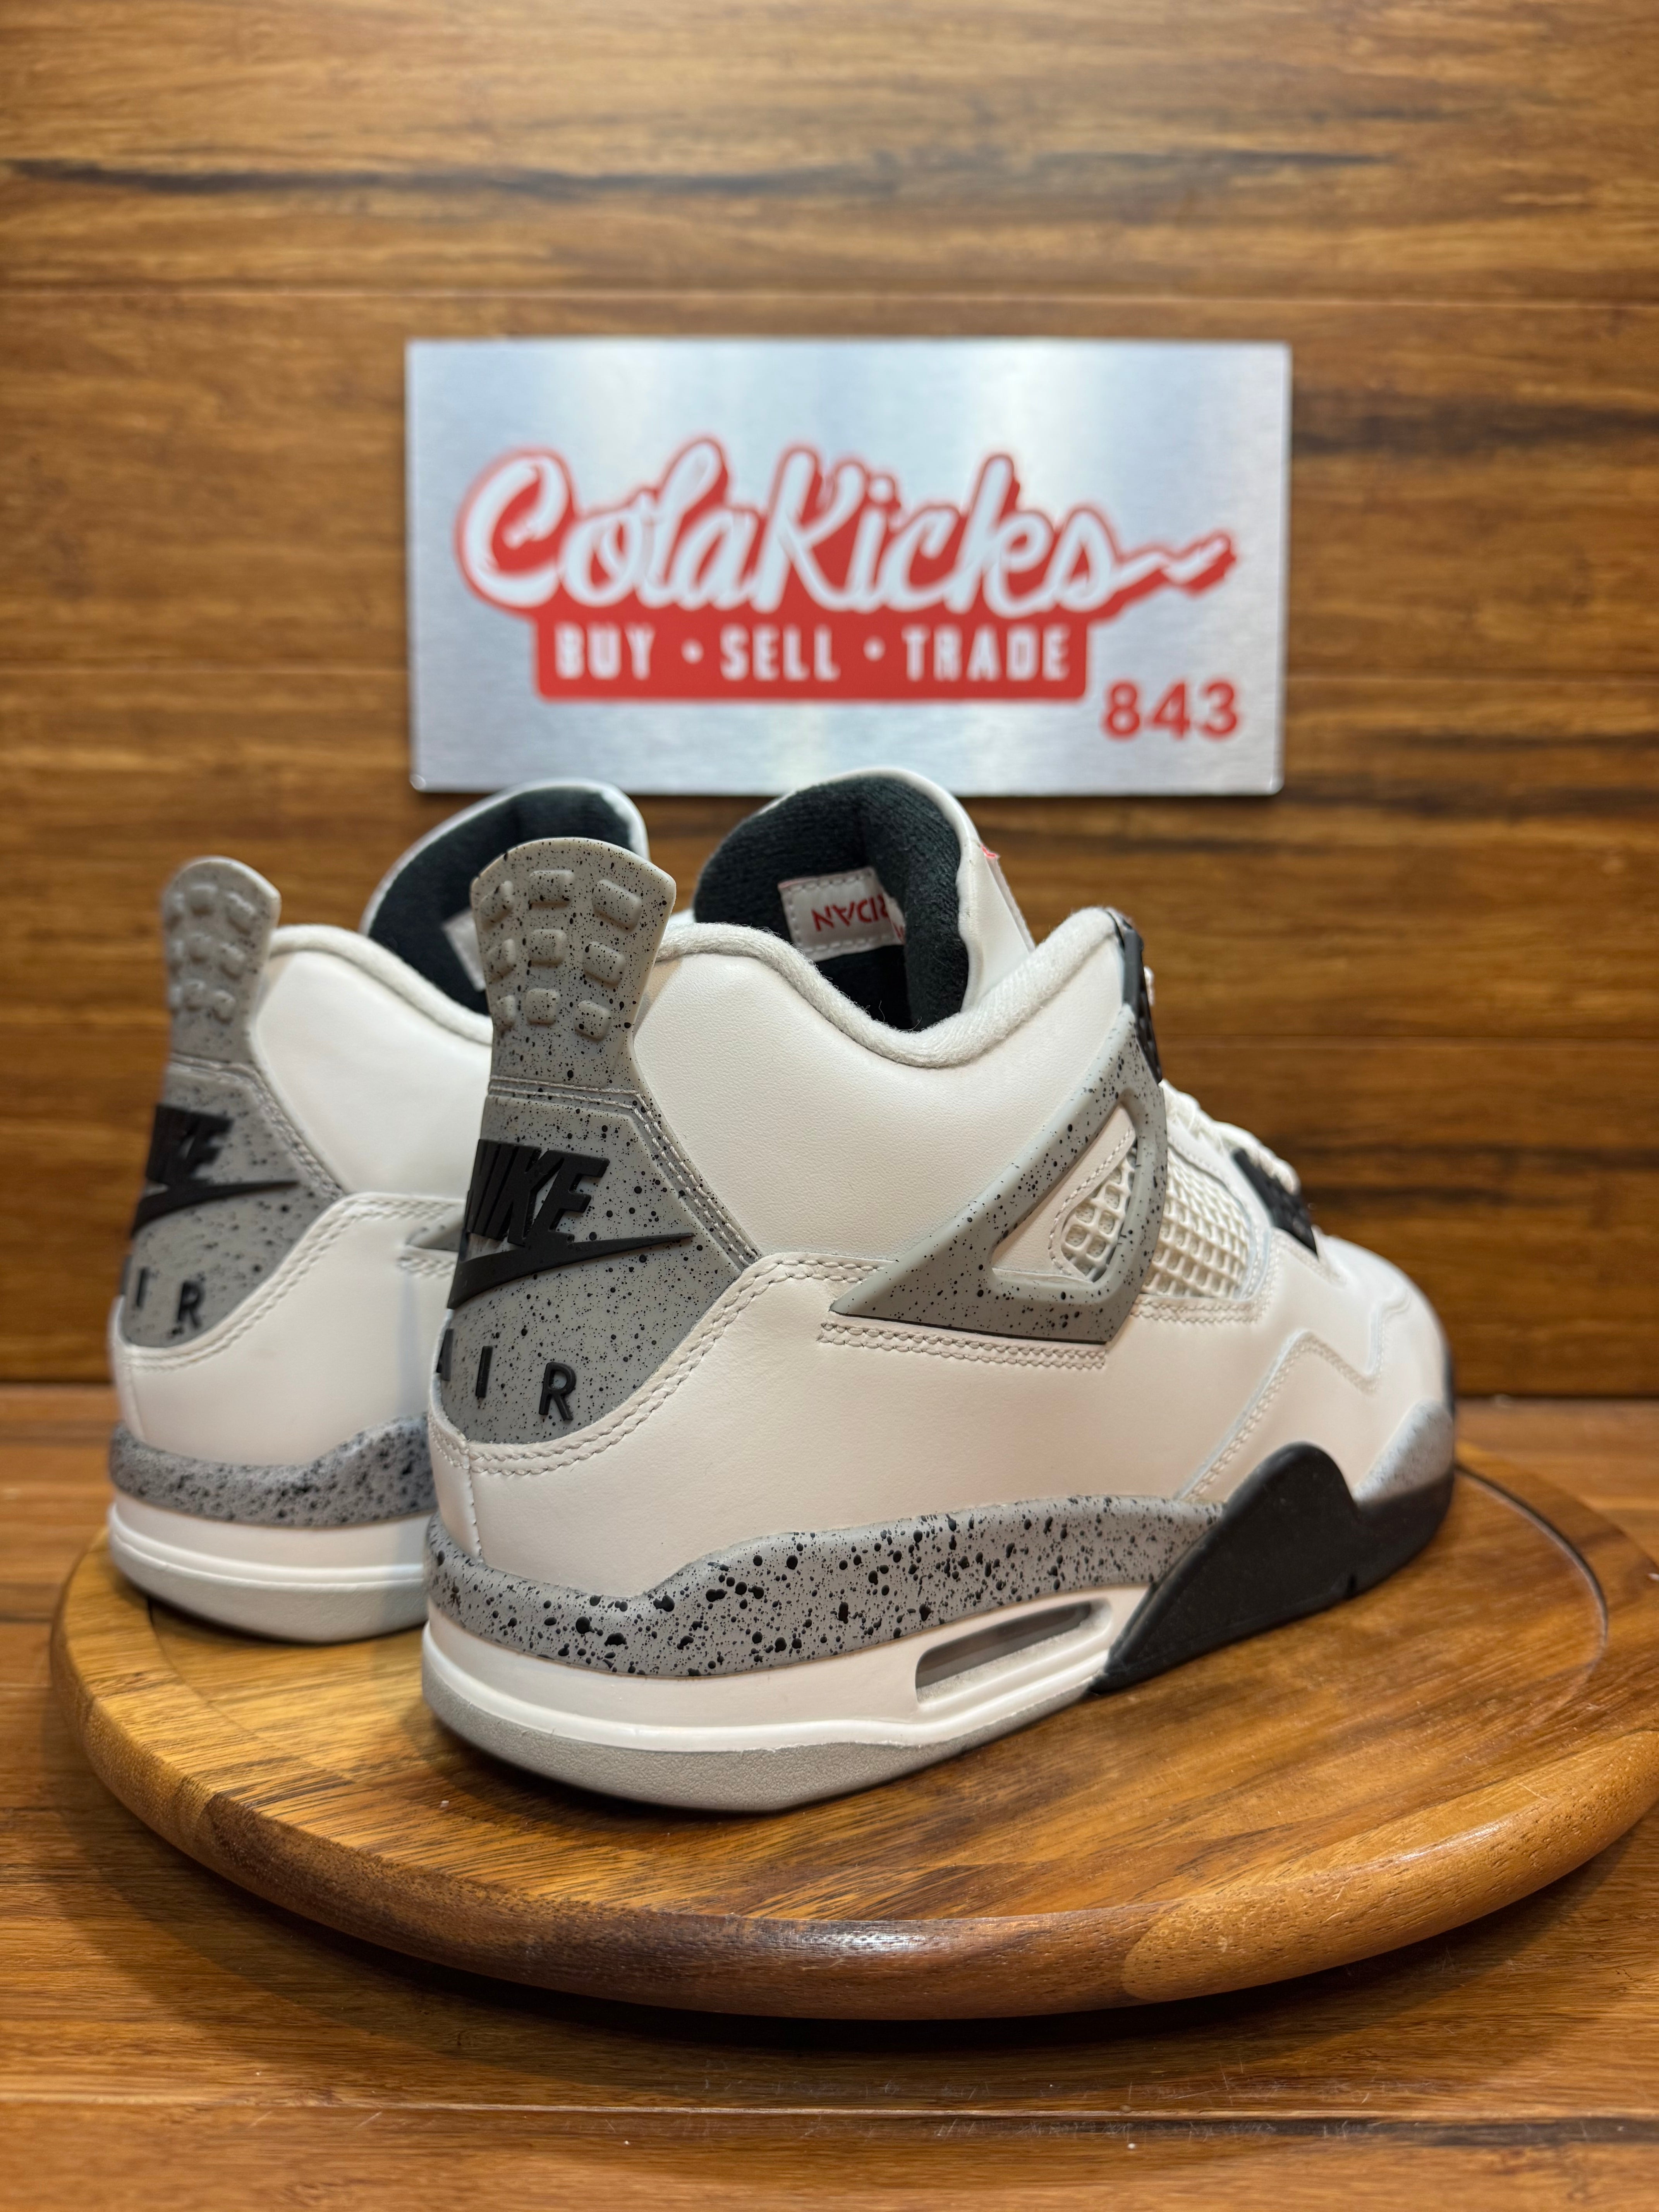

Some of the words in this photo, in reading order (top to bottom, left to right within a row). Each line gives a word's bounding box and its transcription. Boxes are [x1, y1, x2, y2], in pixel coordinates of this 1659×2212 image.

[459, 434, 1235, 620] ColaKicks
[555, 622, 655, 680] BUY
[720, 623, 841, 682] SELL
[902, 623, 1071, 682] TRADE
[1100, 680, 1242, 741] 843
[121, 1255, 205, 1329] IR
